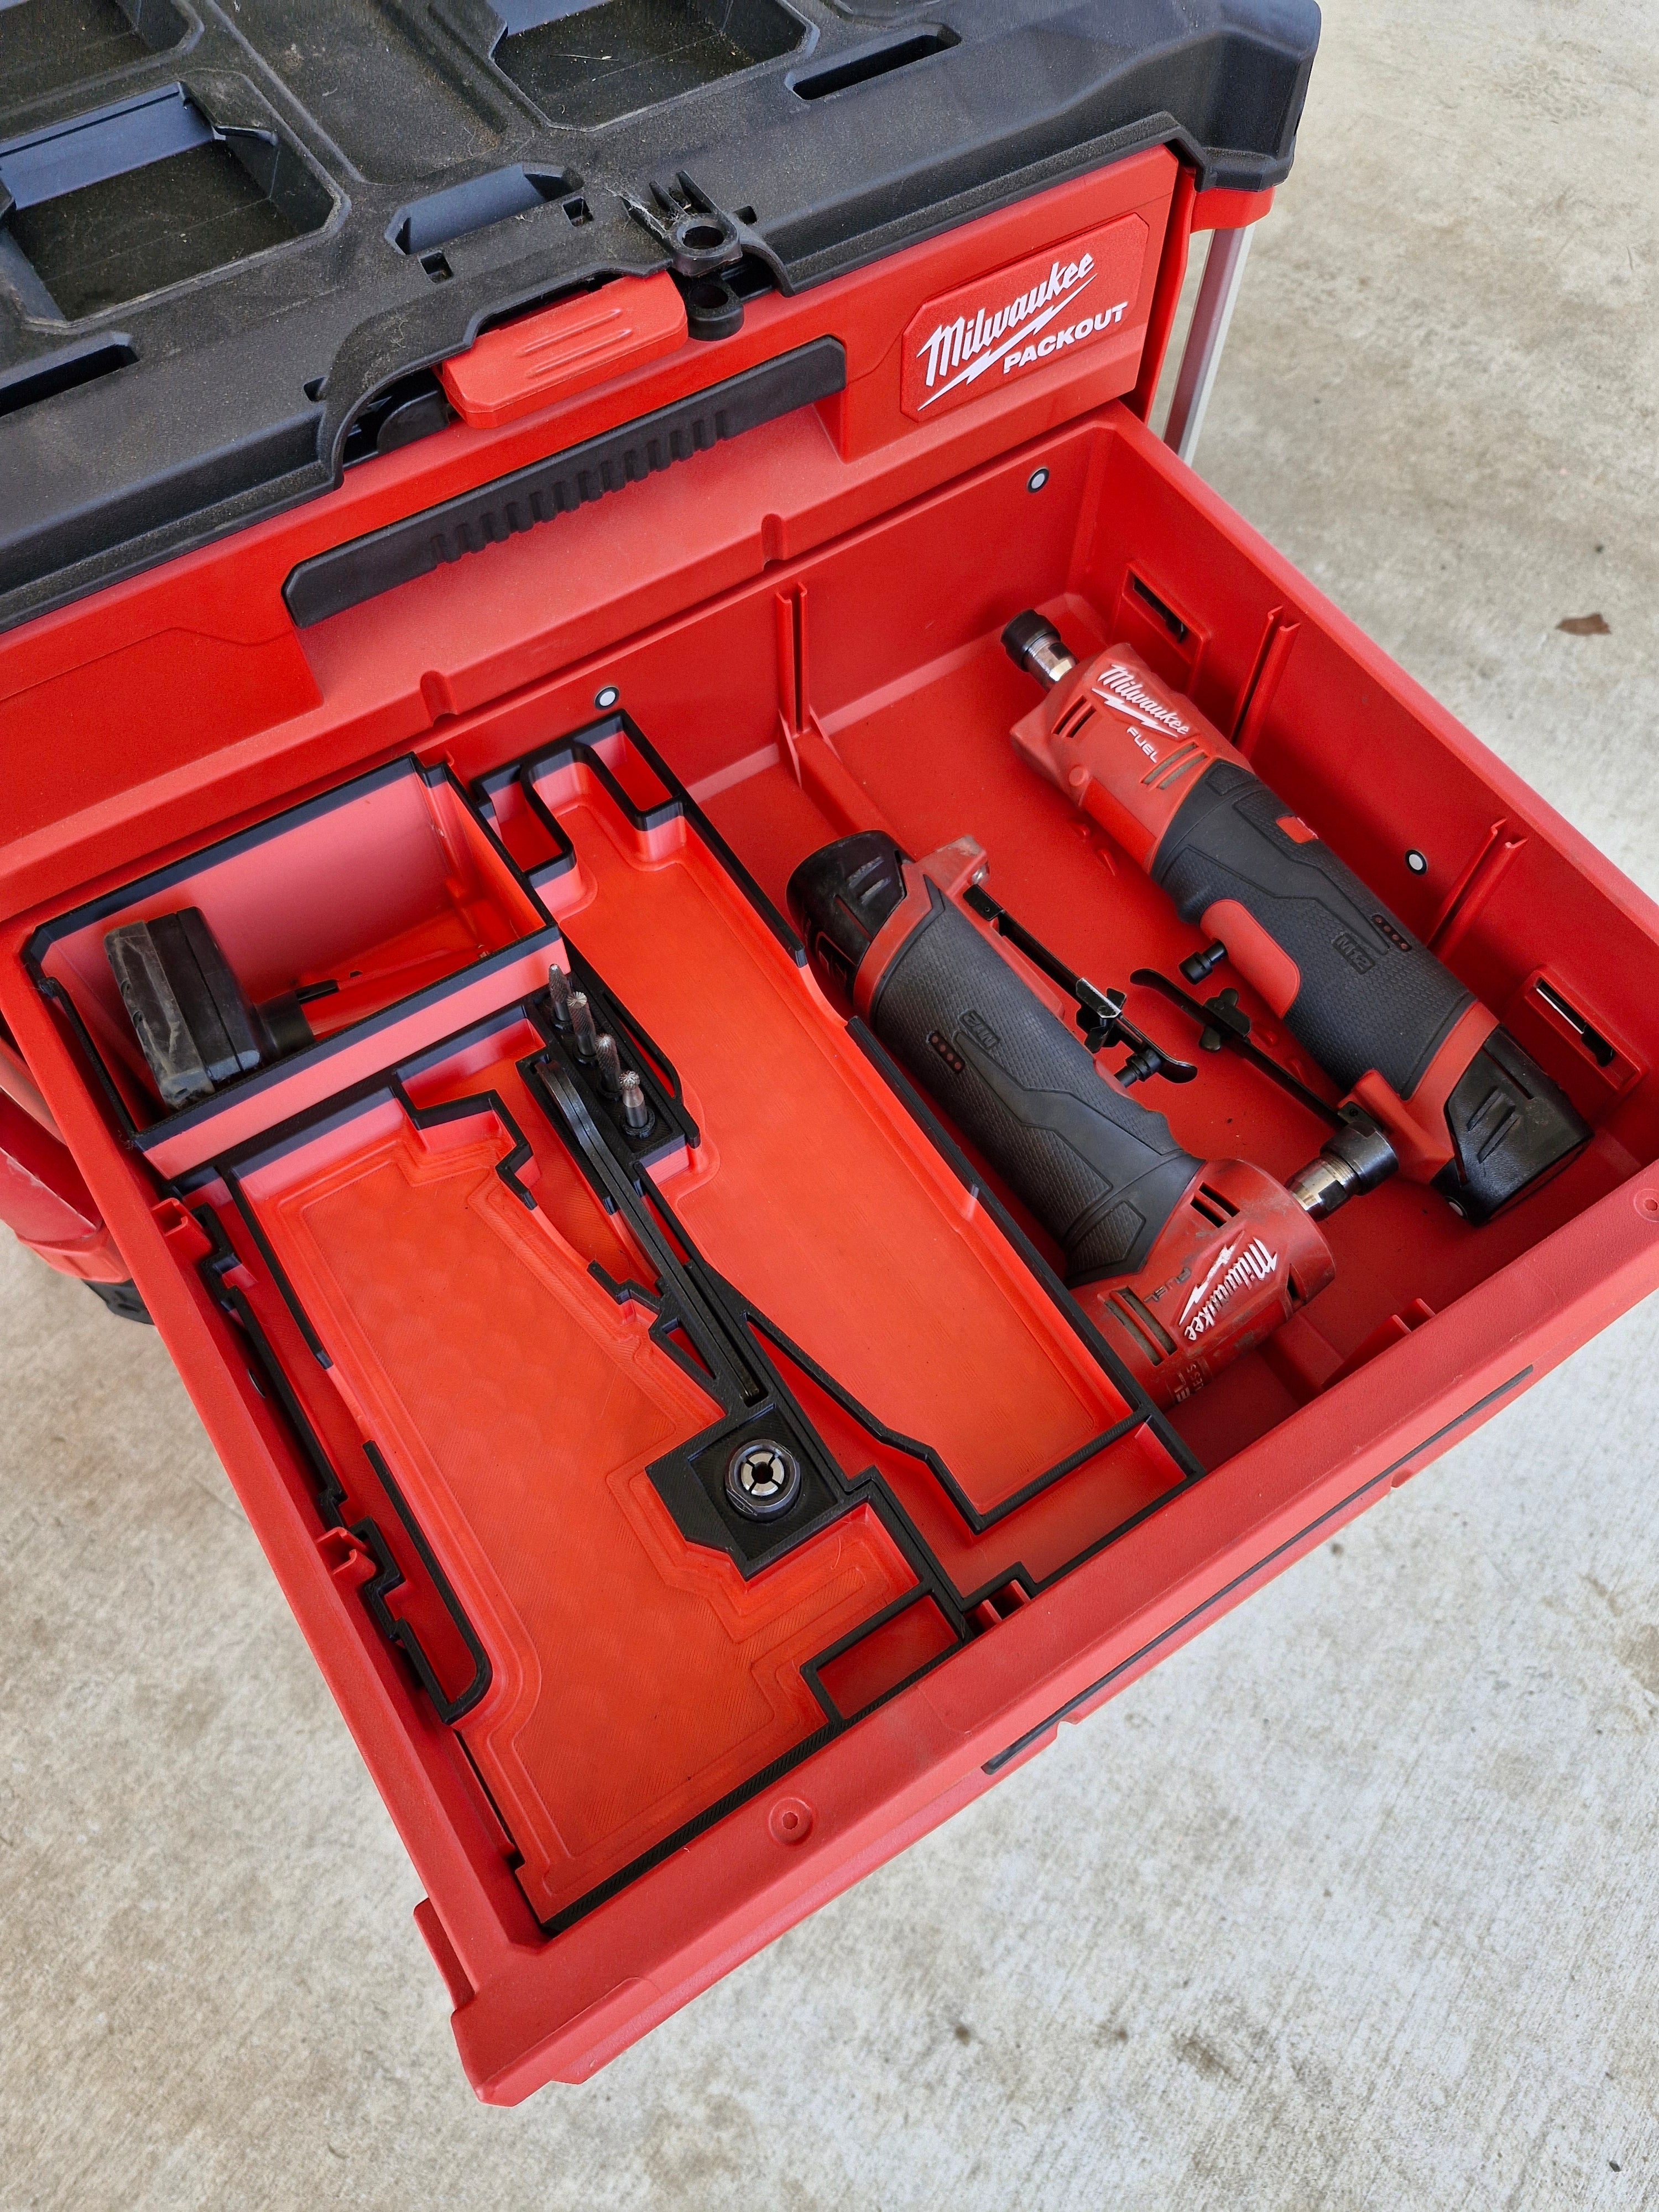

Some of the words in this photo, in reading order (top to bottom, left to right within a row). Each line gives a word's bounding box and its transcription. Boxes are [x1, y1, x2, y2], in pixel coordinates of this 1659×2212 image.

[916, 253, 1094, 387] Milwaukee
[1003, 301, 1128, 374] PACKOUT
[1097, 664, 1189, 735] Milwaukee
[1126, 726, 1157, 763] FUEL
[1335, 935, 1371, 971] M12
[962, 1013, 997, 1048] M12
[1184, 1237, 1277, 1341] Milwaukee
